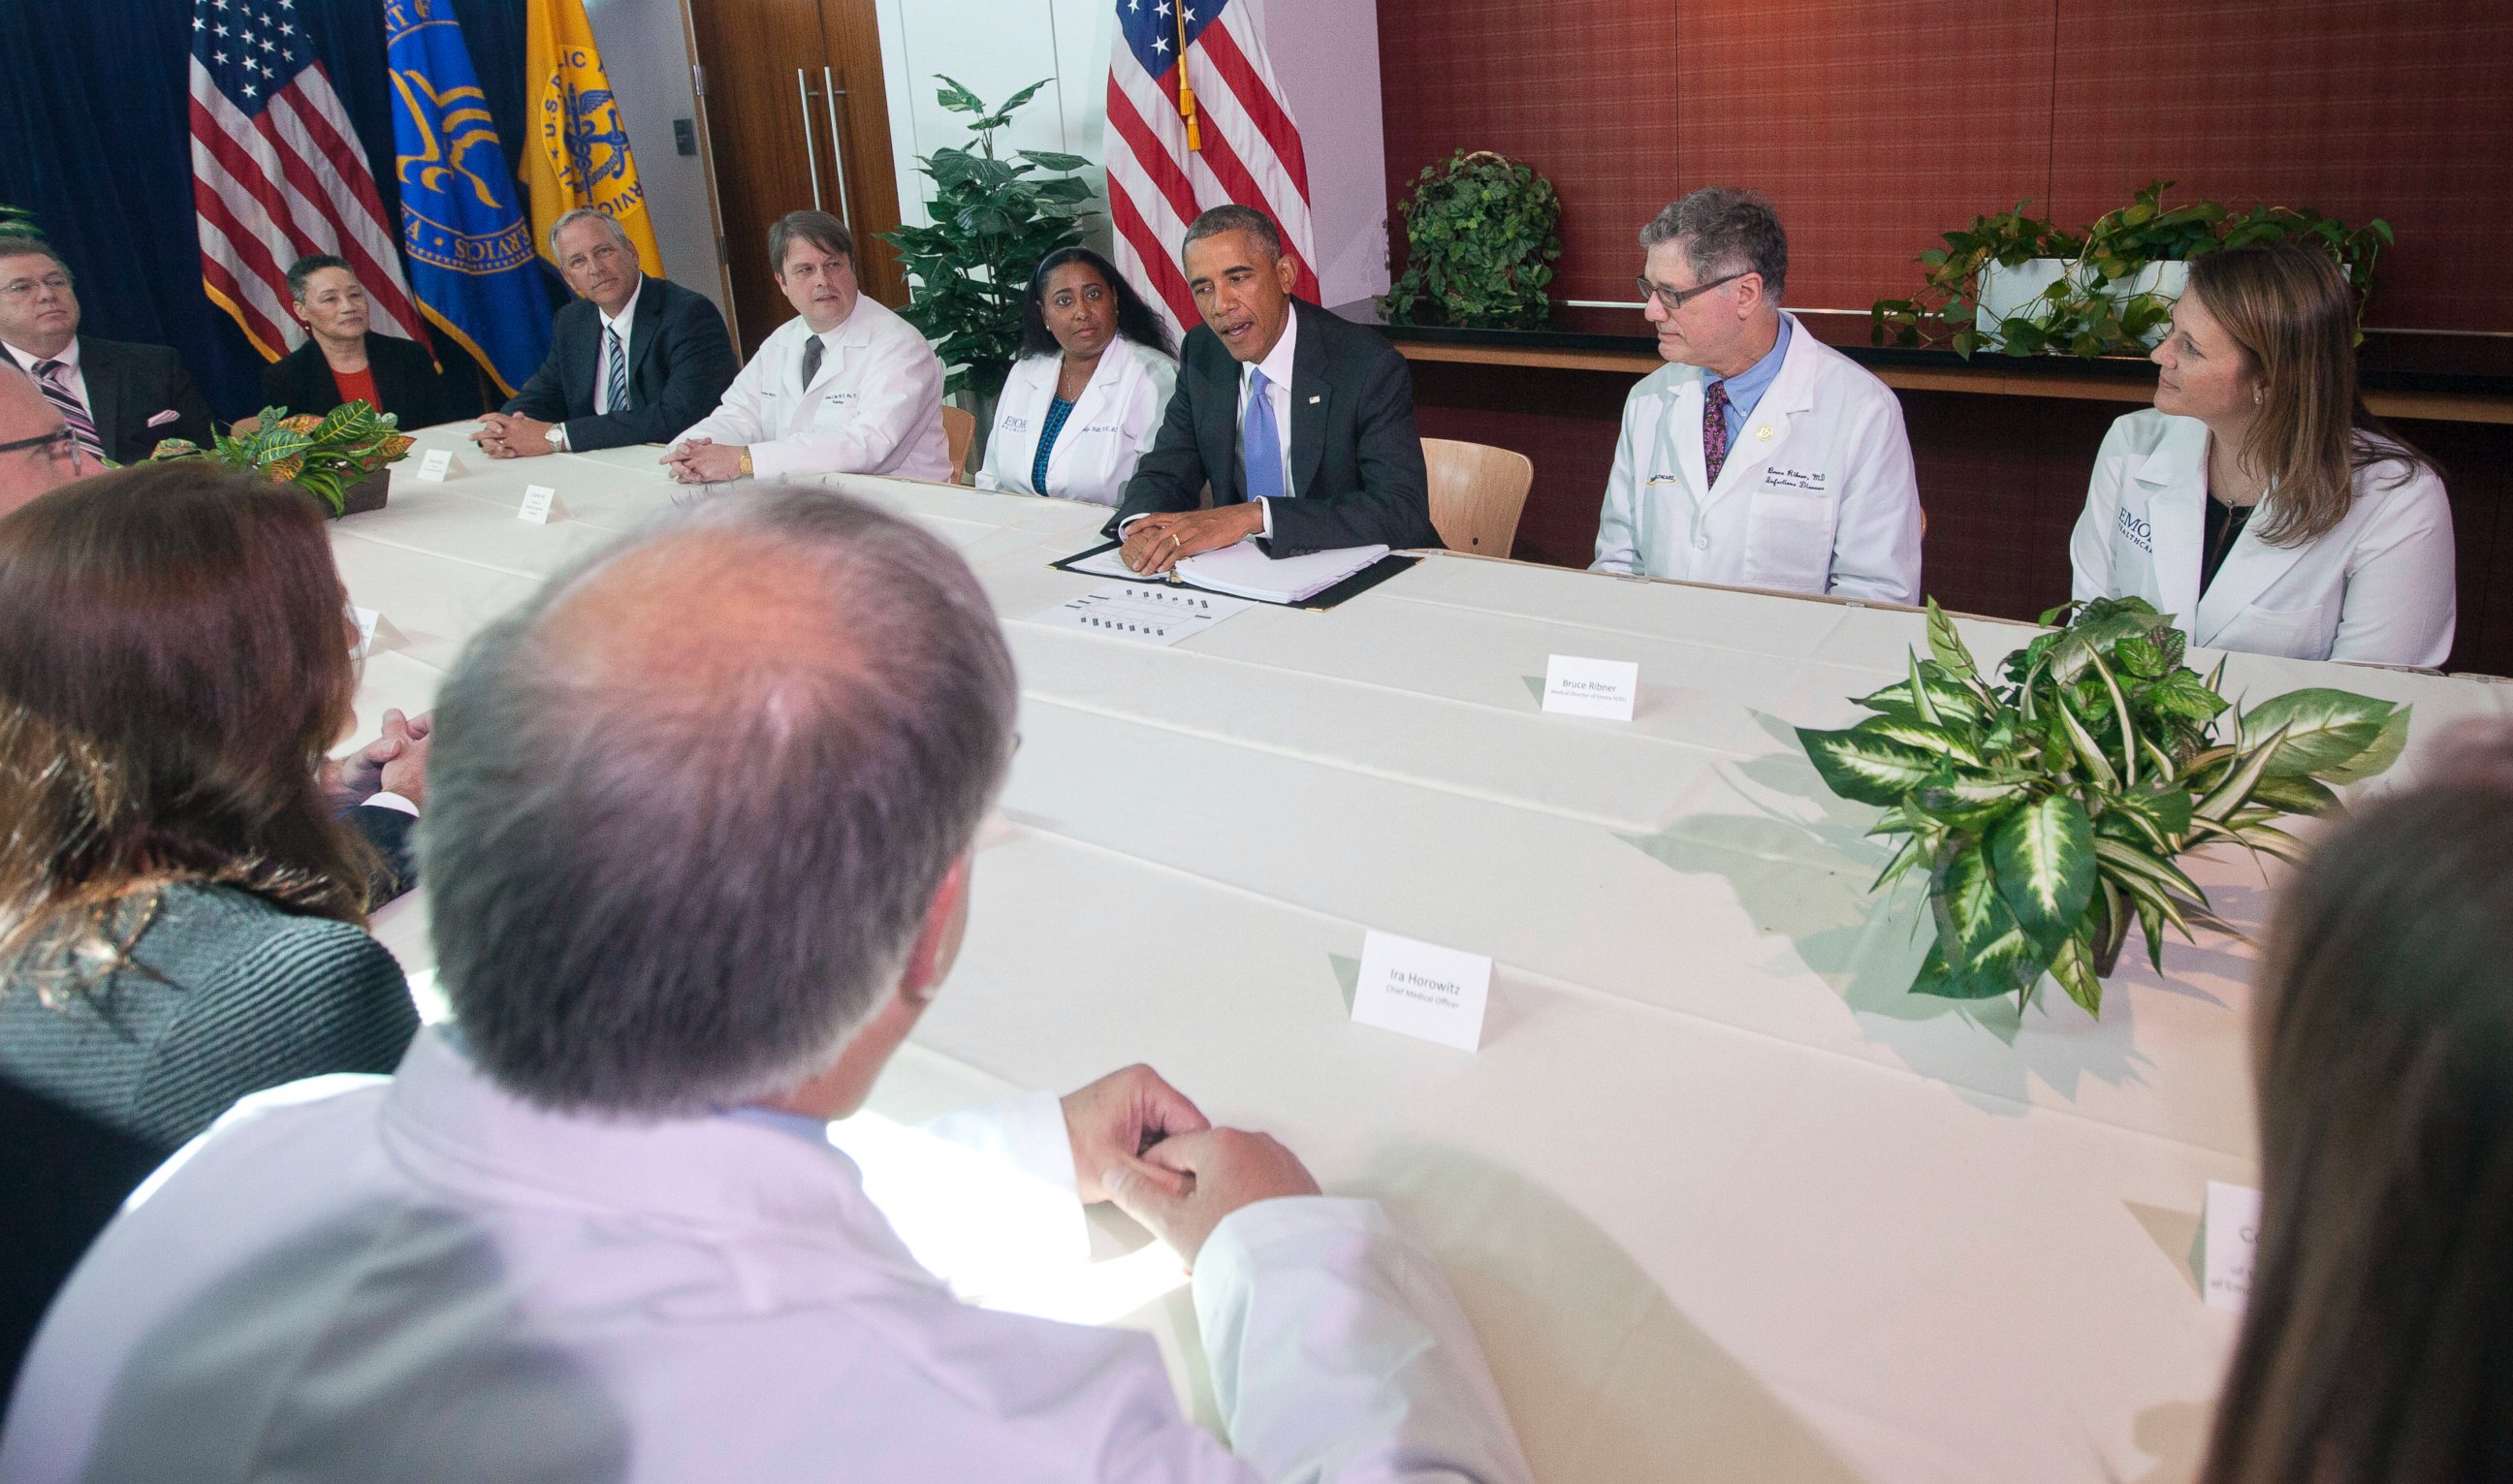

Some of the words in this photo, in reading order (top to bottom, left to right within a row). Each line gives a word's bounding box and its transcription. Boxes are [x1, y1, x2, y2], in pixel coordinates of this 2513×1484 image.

[1562, 679, 1587, 689] Bruce
[1589, 681, 1617, 692] Ribner
[1390, 968, 1405, 982] Ira
[1408, 972, 1460, 995] Horowitz
[1385, 985, 1405, 994] Chief
[1406, 990, 1434, 1002] Medical
[1435, 996, 1460, 1009] Officer
